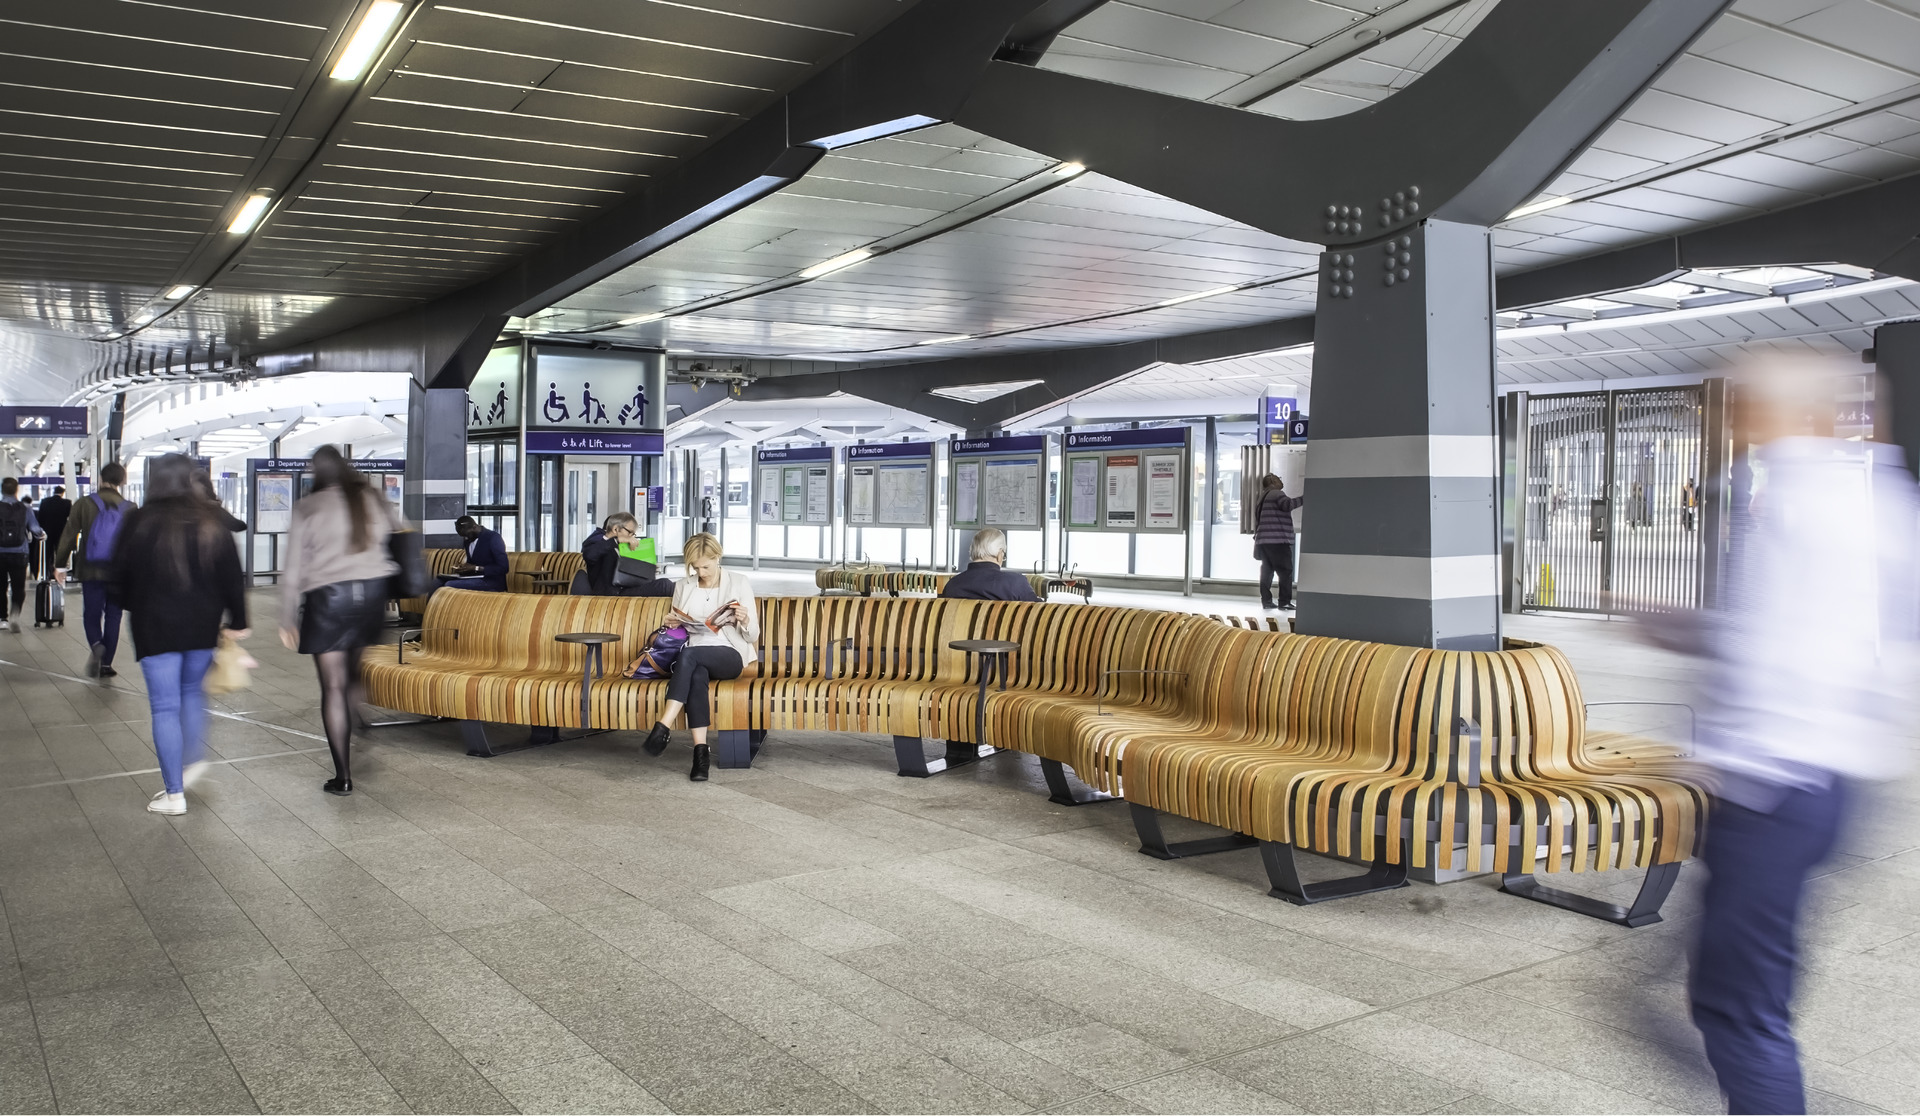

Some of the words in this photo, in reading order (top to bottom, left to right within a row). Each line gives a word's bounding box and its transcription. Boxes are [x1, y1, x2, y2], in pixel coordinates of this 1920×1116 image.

[1274, 402, 1291, 420] 10
[589, 439, 603, 448] Lift
[1078, 435, 1112, 443] Information
